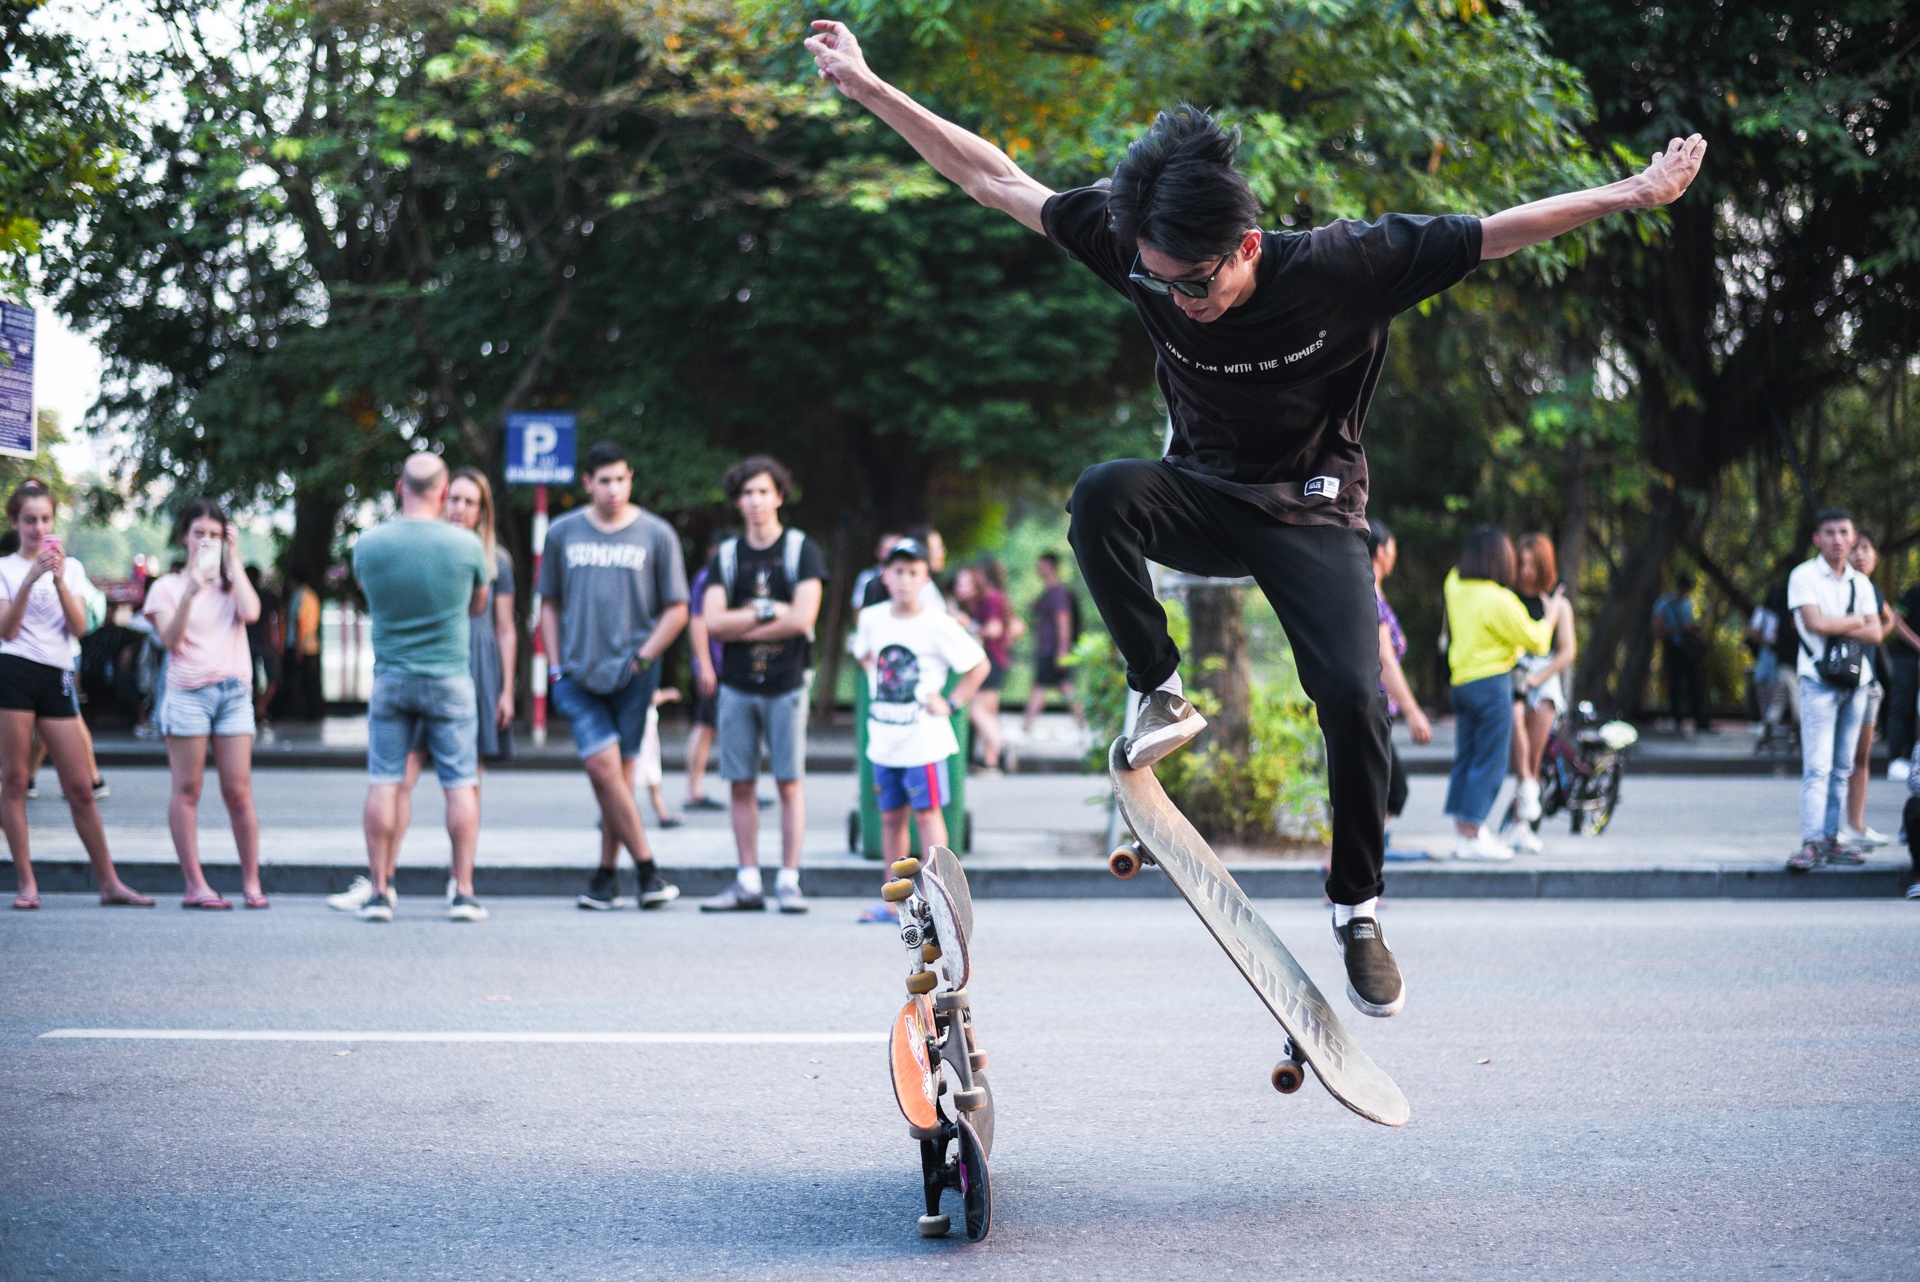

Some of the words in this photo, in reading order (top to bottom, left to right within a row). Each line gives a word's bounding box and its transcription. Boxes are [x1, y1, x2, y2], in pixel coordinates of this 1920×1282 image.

[1224, 363, 1252, 374] WITH
[1257, 359, 1280, 371] THE
[522, 422, 558, 470] P
[1230, 936, 1345, 1072] SHAKE
